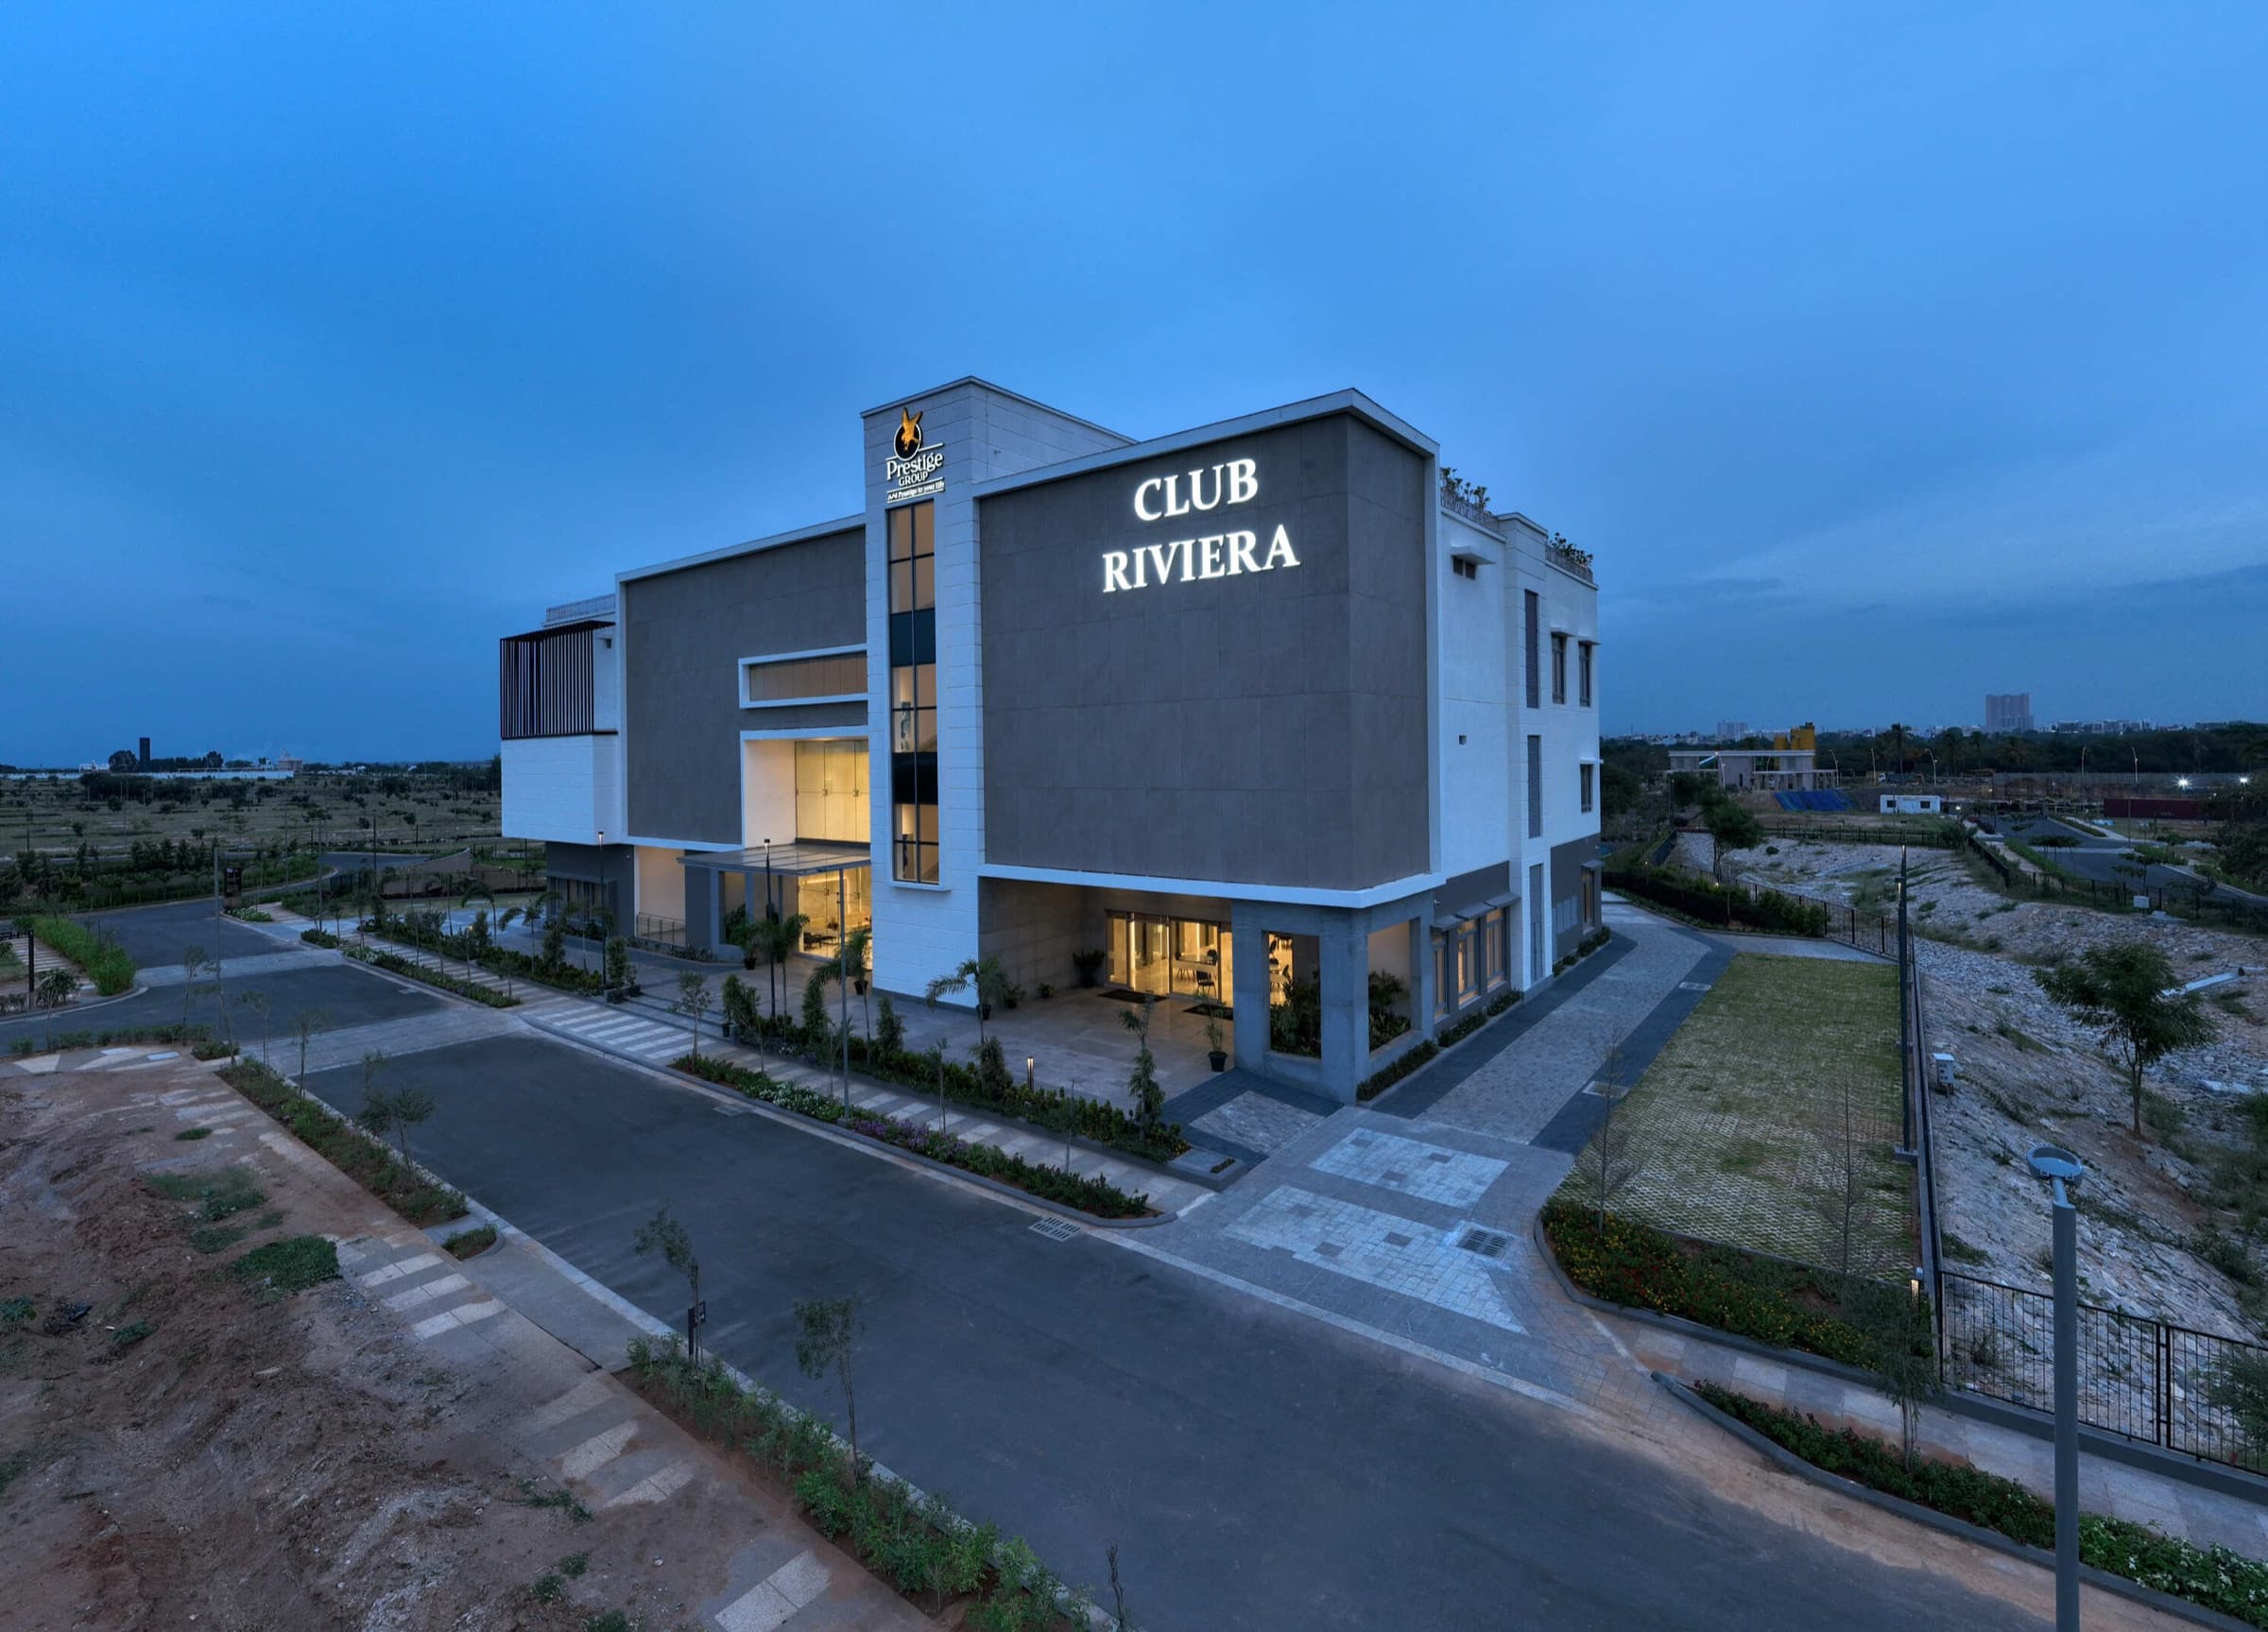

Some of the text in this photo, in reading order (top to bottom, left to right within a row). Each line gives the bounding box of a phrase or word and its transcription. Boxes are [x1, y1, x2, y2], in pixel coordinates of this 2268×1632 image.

[886, 453, 943, 480] Prestige
[899, 471, 928, 487] GROUP
[1134, 458, 1259, 522] CLUB
[1102, 524, 1302, 593] RIVIERA
